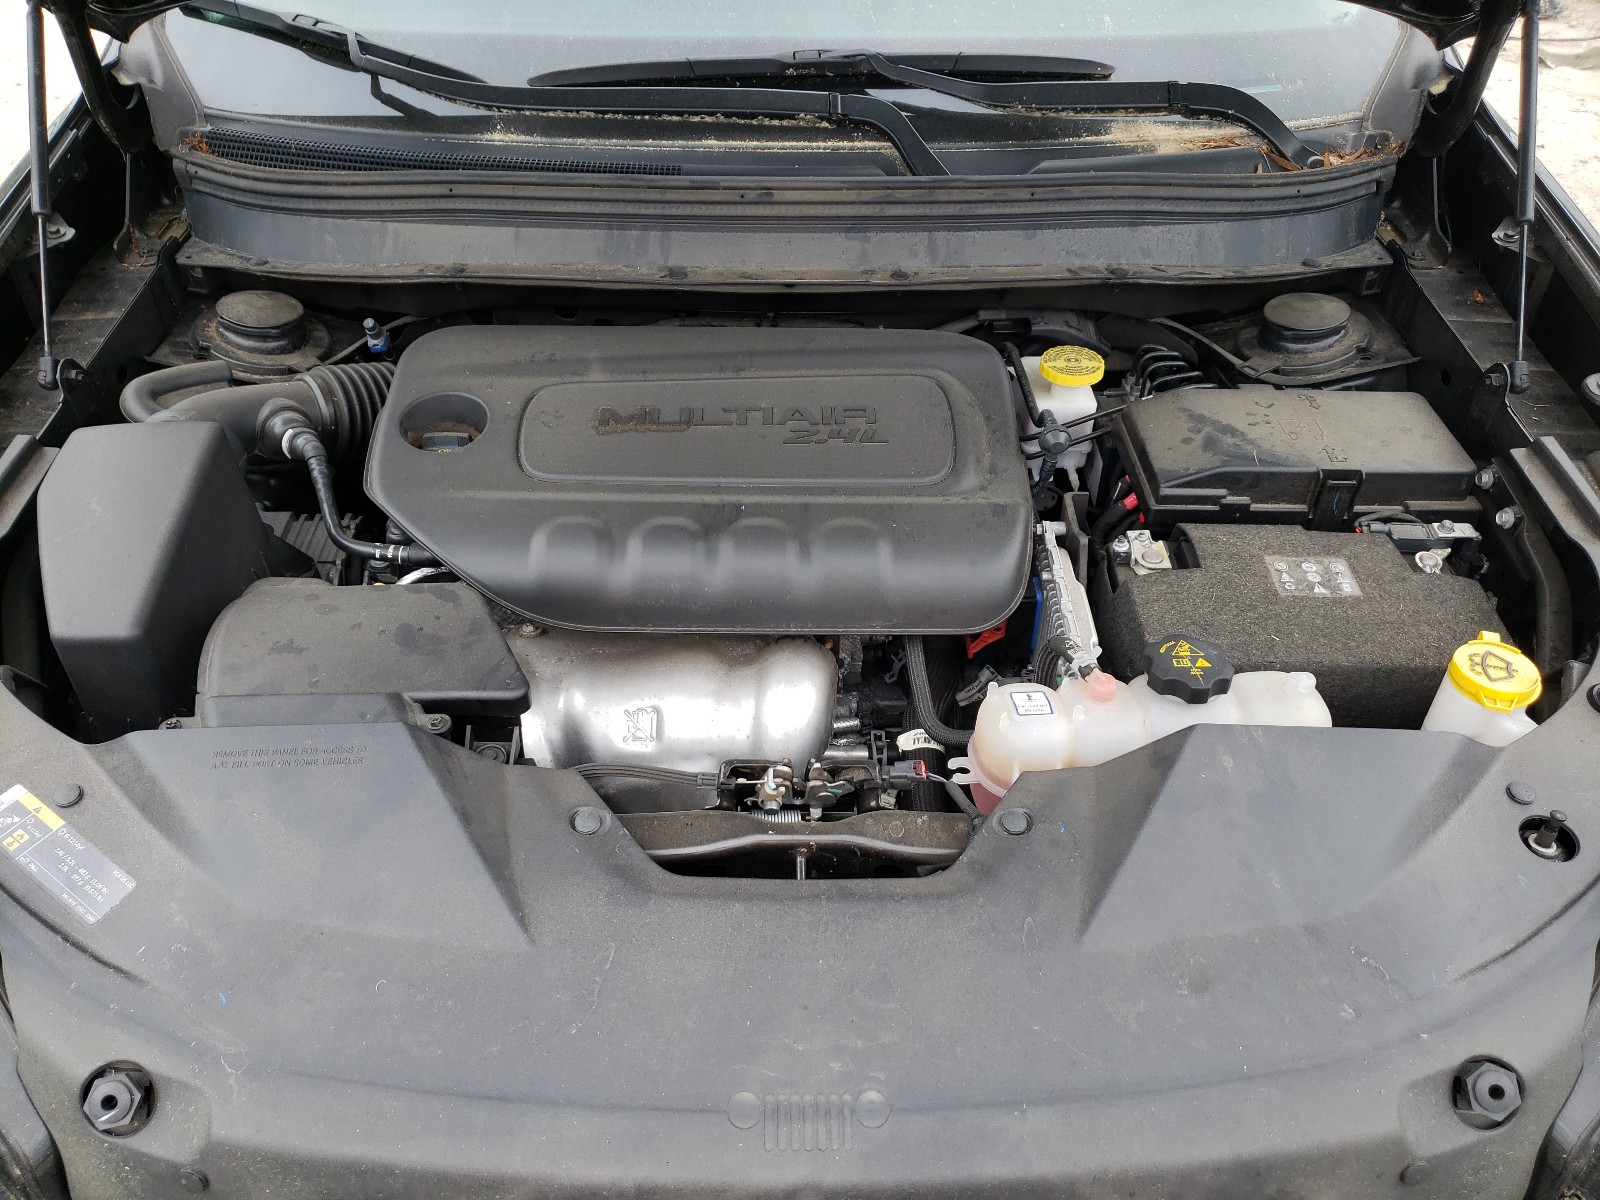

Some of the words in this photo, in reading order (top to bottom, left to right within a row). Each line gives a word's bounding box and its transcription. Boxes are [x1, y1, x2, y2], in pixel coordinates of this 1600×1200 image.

[599, 406, 876, 427] MULTIAIR
[783, 428, 889, 445] 2.4L
[212, 749, 249, 759] REMOVE
[250, 748, 270, 758] THIS
[272, 747, 299, 757] PANEL
[301, 747, 319, 756] FOR
[320, 745, 354, 755] ACCESS
[357, 745, 368, 755] TO
[209, 760, 228, 769] A/C
[231, 760, 249, 769] FILL
[252, 759, 276, 768] PORT
[278, 759, 292, 768] ON
[293, 758, 319, 767] SOME
[322, 756, 364, 766] VEHICLES
